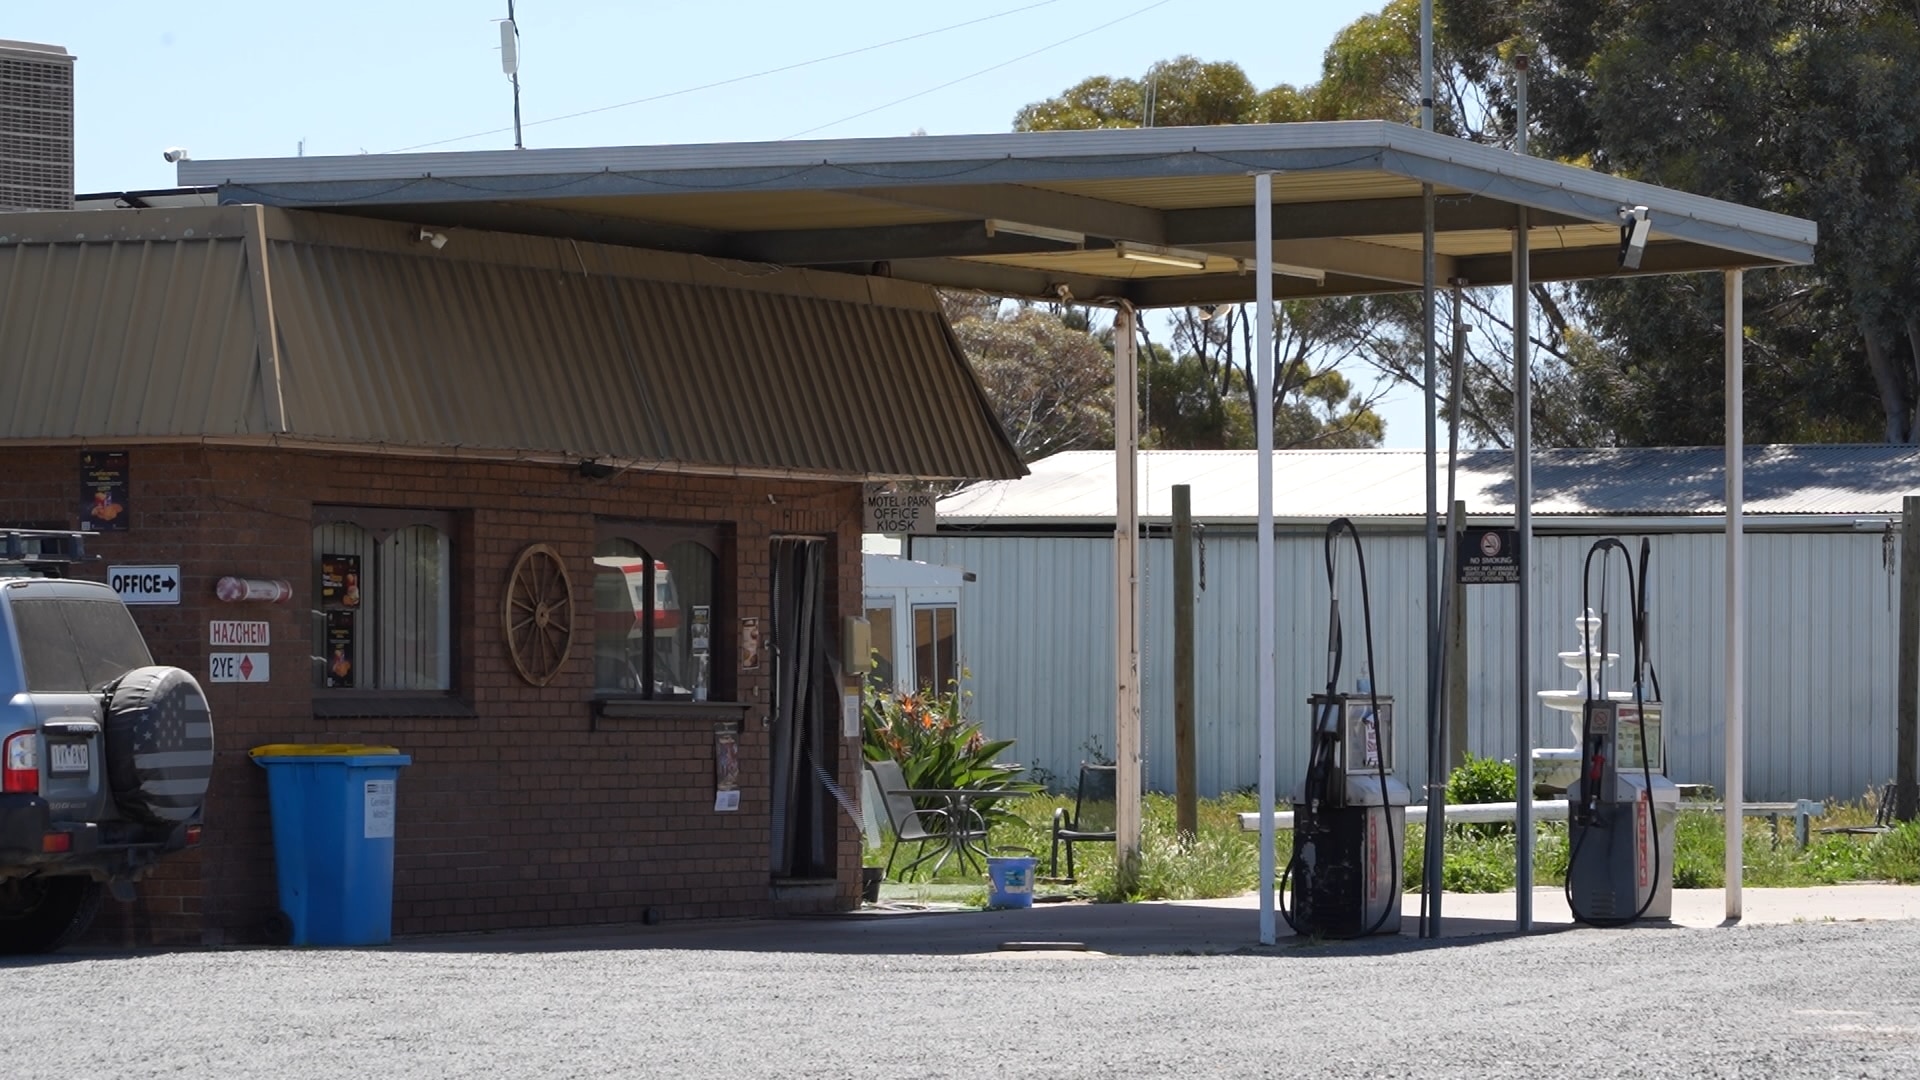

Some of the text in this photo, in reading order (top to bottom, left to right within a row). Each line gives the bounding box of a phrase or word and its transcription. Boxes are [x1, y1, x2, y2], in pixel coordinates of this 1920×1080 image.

[868, 496, 900, 507] MOTEL
[907, 496, 931, 506] PARK
[873, 507, 919, 519] OFFICE
[876, 520, 916, 531] KIOSK
[113, 574, 161, 594] OFFICE
[213, 623, 267, 644] HAZCHEM
[212, 657, 234, 678] 2YE
